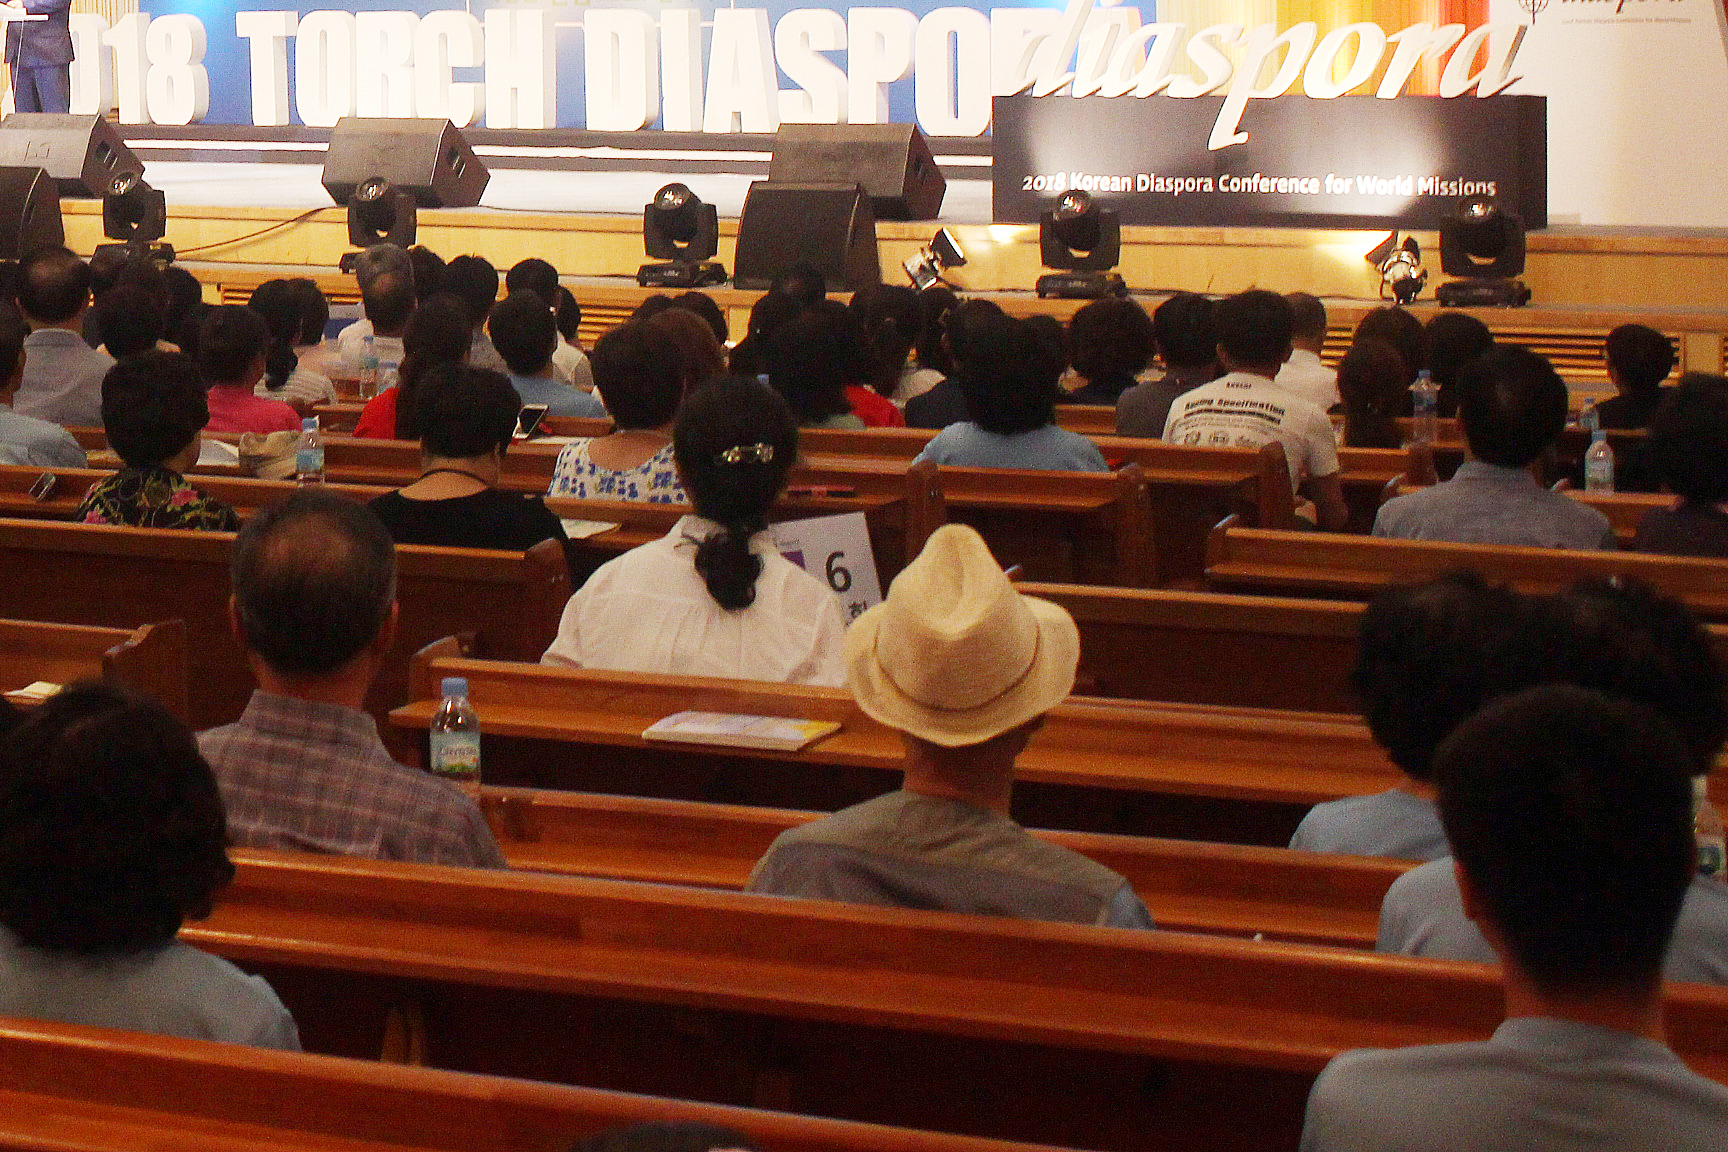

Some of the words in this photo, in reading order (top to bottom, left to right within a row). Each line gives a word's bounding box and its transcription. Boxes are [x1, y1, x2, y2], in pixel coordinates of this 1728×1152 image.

[235, 8, 557, 129] TORCH
[1022, 172, 1066, 193] 2018
[1070, 173, 1132, 193] Korean
[1136, 172, 1214, 196] Diaspora
[1219, 173, 1320, 195] Conference
[1325, 173, 1352, 194] for
[1356, 174, 1413, 196] World
[1417, 176, 1498, 198] Missions
[824, 550, 853, 594] 6
